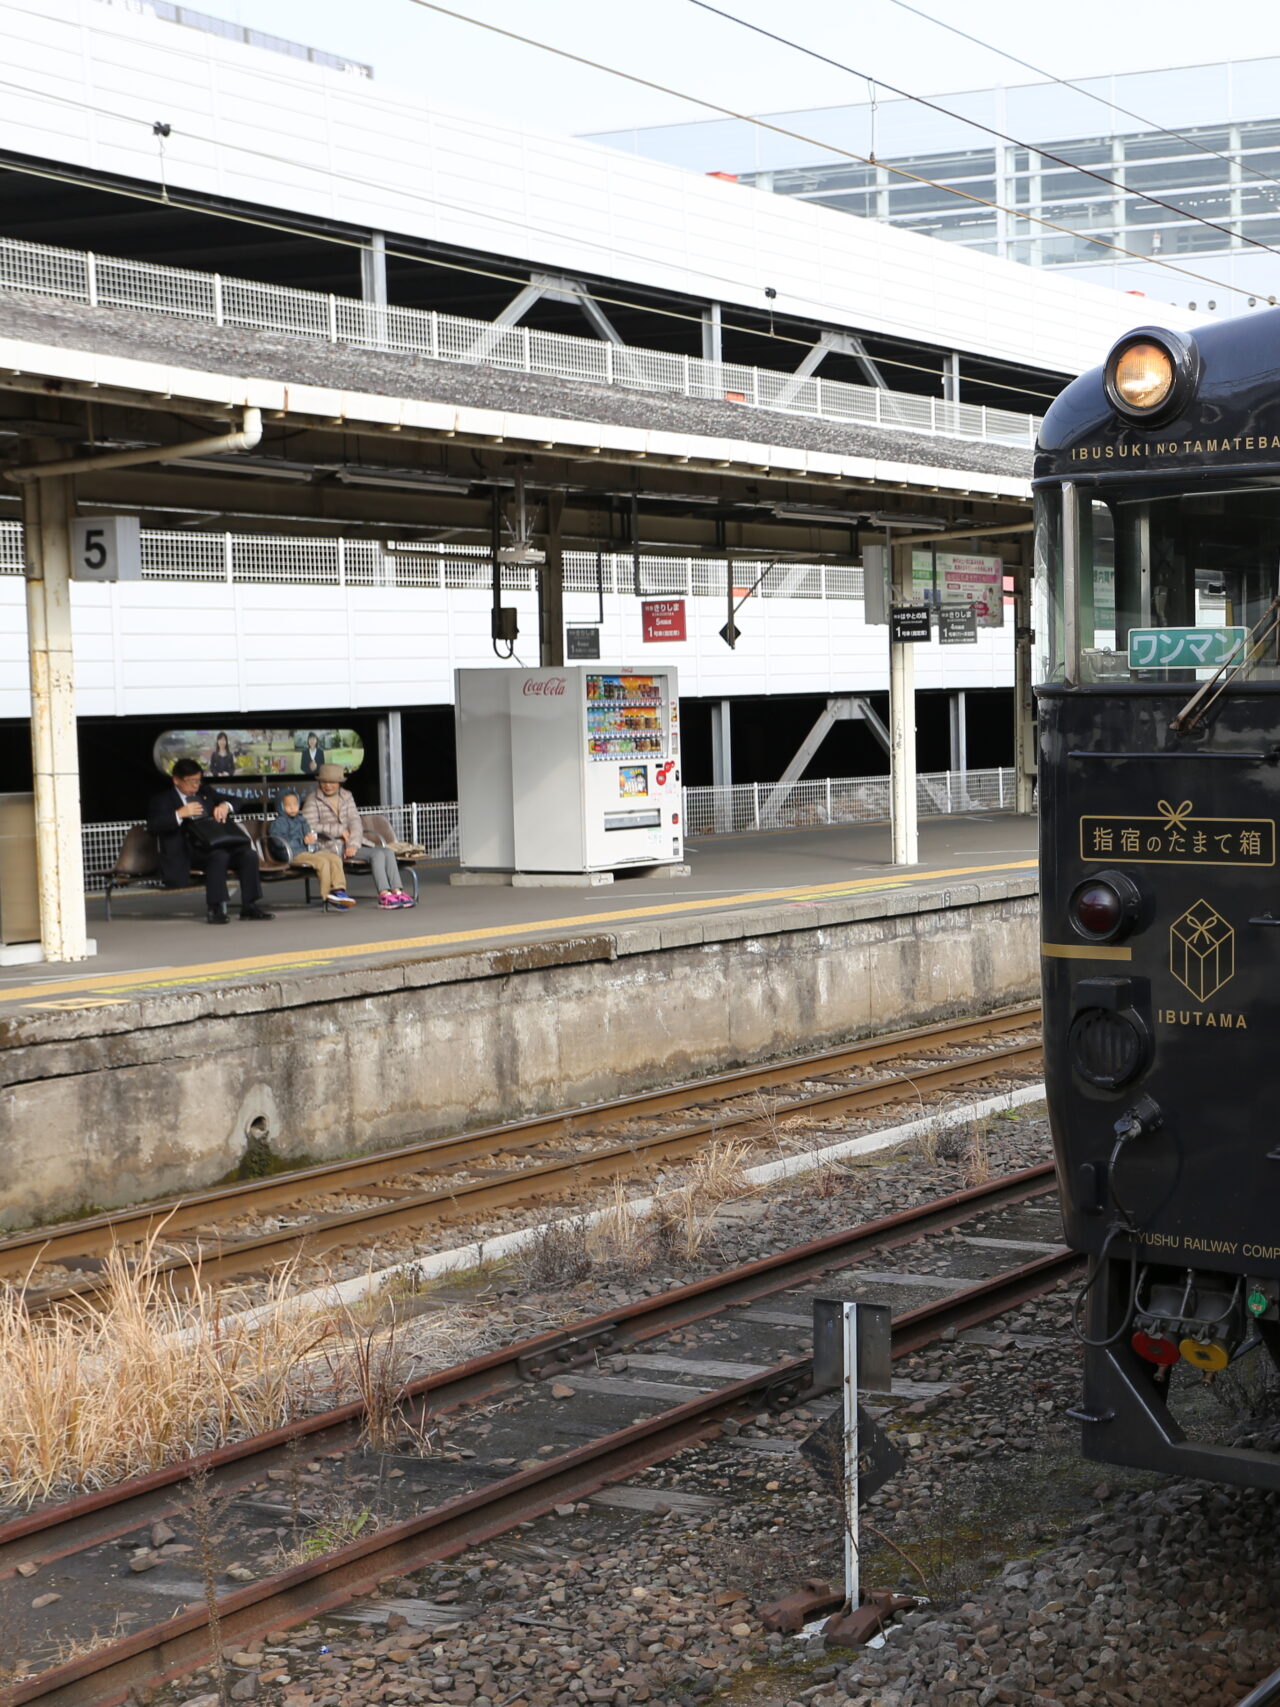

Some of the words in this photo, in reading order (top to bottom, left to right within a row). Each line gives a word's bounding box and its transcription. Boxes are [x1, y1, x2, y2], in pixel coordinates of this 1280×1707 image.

[1072, 443, 1149, 461] IBUSUKI
[1157, 442, 1178, 454] NO
[84, 529, 107, 570] 5
[1133, 633, 1241, 664] ワンマン
[1093, 827, 1263, 856] 指宿のたまて箱
[1158, 1009, 1247, 1029] IBUTAMA
[1129, 1232, 1180, 1248] YUSHU
[1184, 1237, 1238, 1255] RAILWAY
